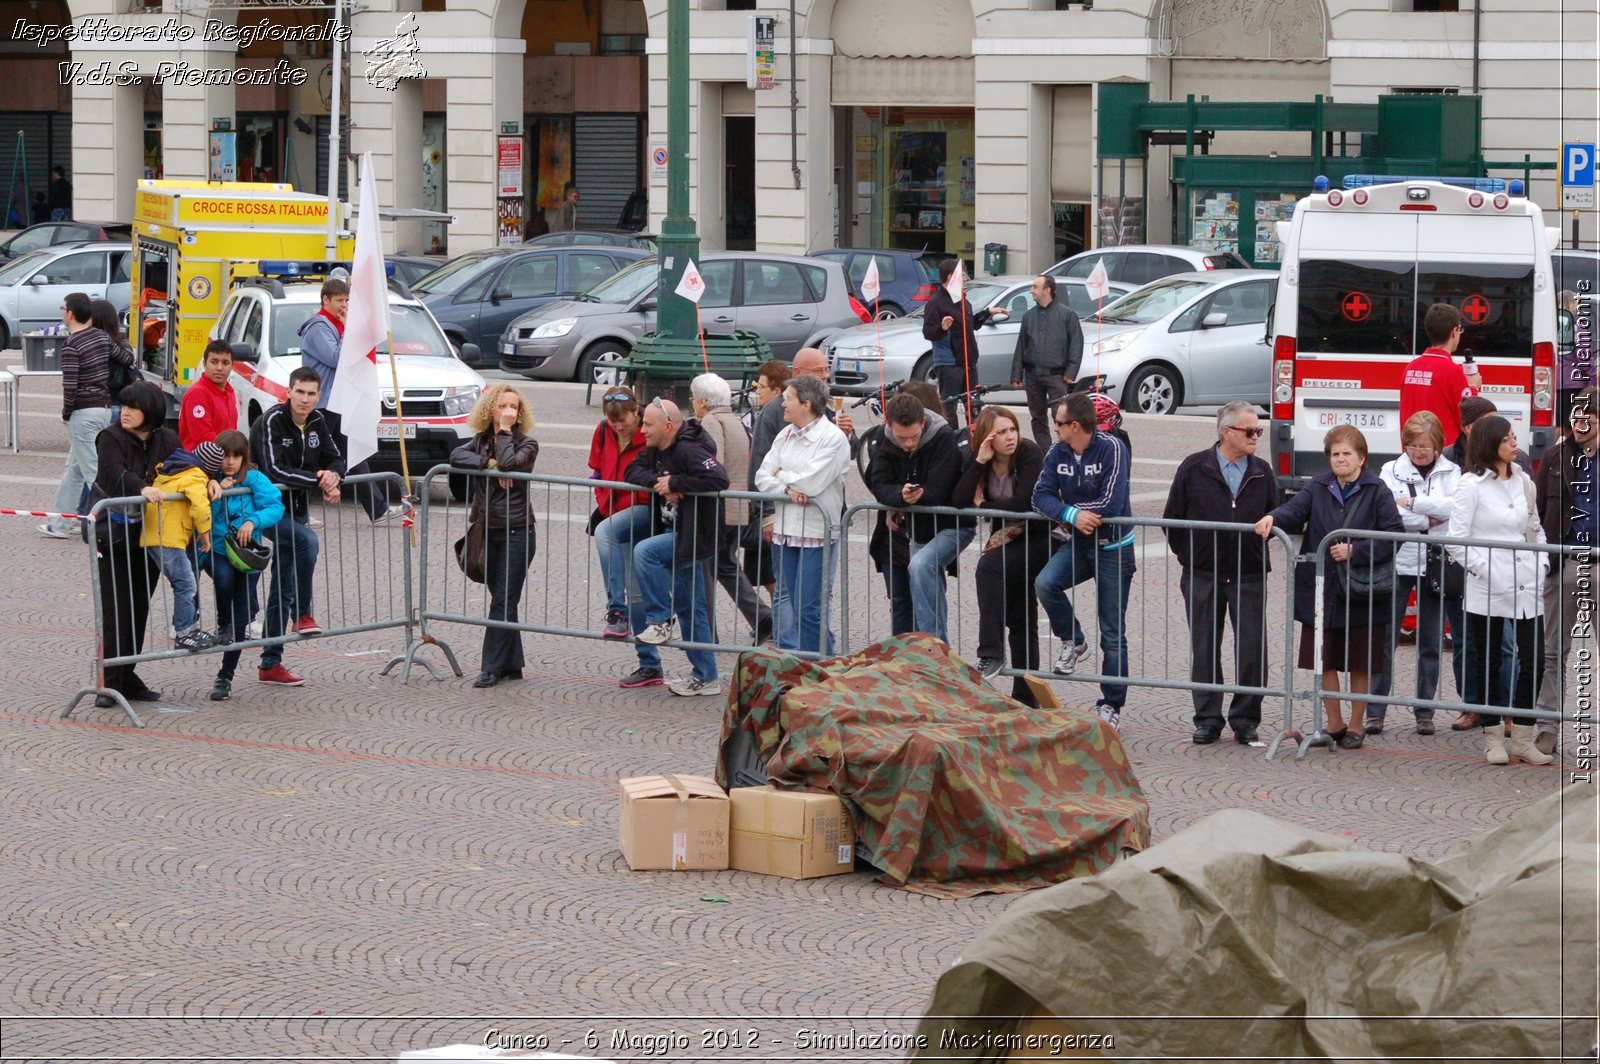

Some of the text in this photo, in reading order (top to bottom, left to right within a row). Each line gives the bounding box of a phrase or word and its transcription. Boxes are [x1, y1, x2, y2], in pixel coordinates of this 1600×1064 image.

[1568, 147, 1588, 182] P
[193, 201, 328, 217] CROCE ROSSA ITALIANA
[1056, 213, 1073, 222] FAX
[1304, 380, 1358, 388] PEUGEOT
